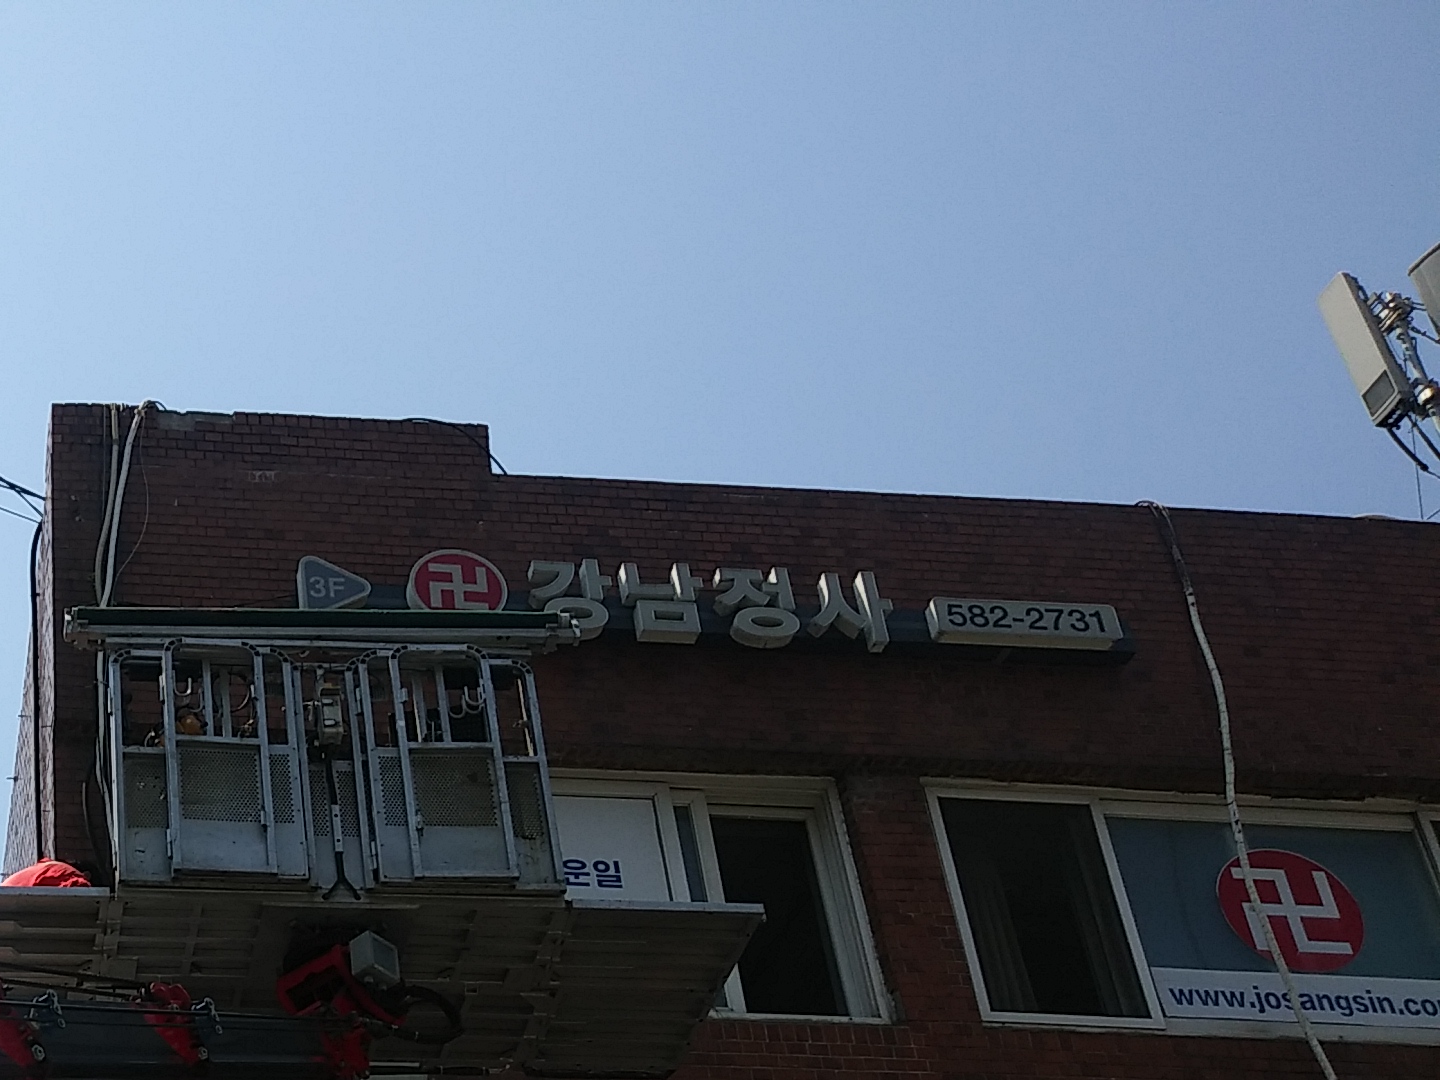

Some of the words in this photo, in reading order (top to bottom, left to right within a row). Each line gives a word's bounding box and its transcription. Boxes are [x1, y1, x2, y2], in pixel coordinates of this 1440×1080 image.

[308, 575, 346, 600] 3F
[527, 557, 894, 654] 강남정사
[947, 603, 1106, 633] 582-2731
[1169, 985, 1440, 1017] www.josangsin.co
